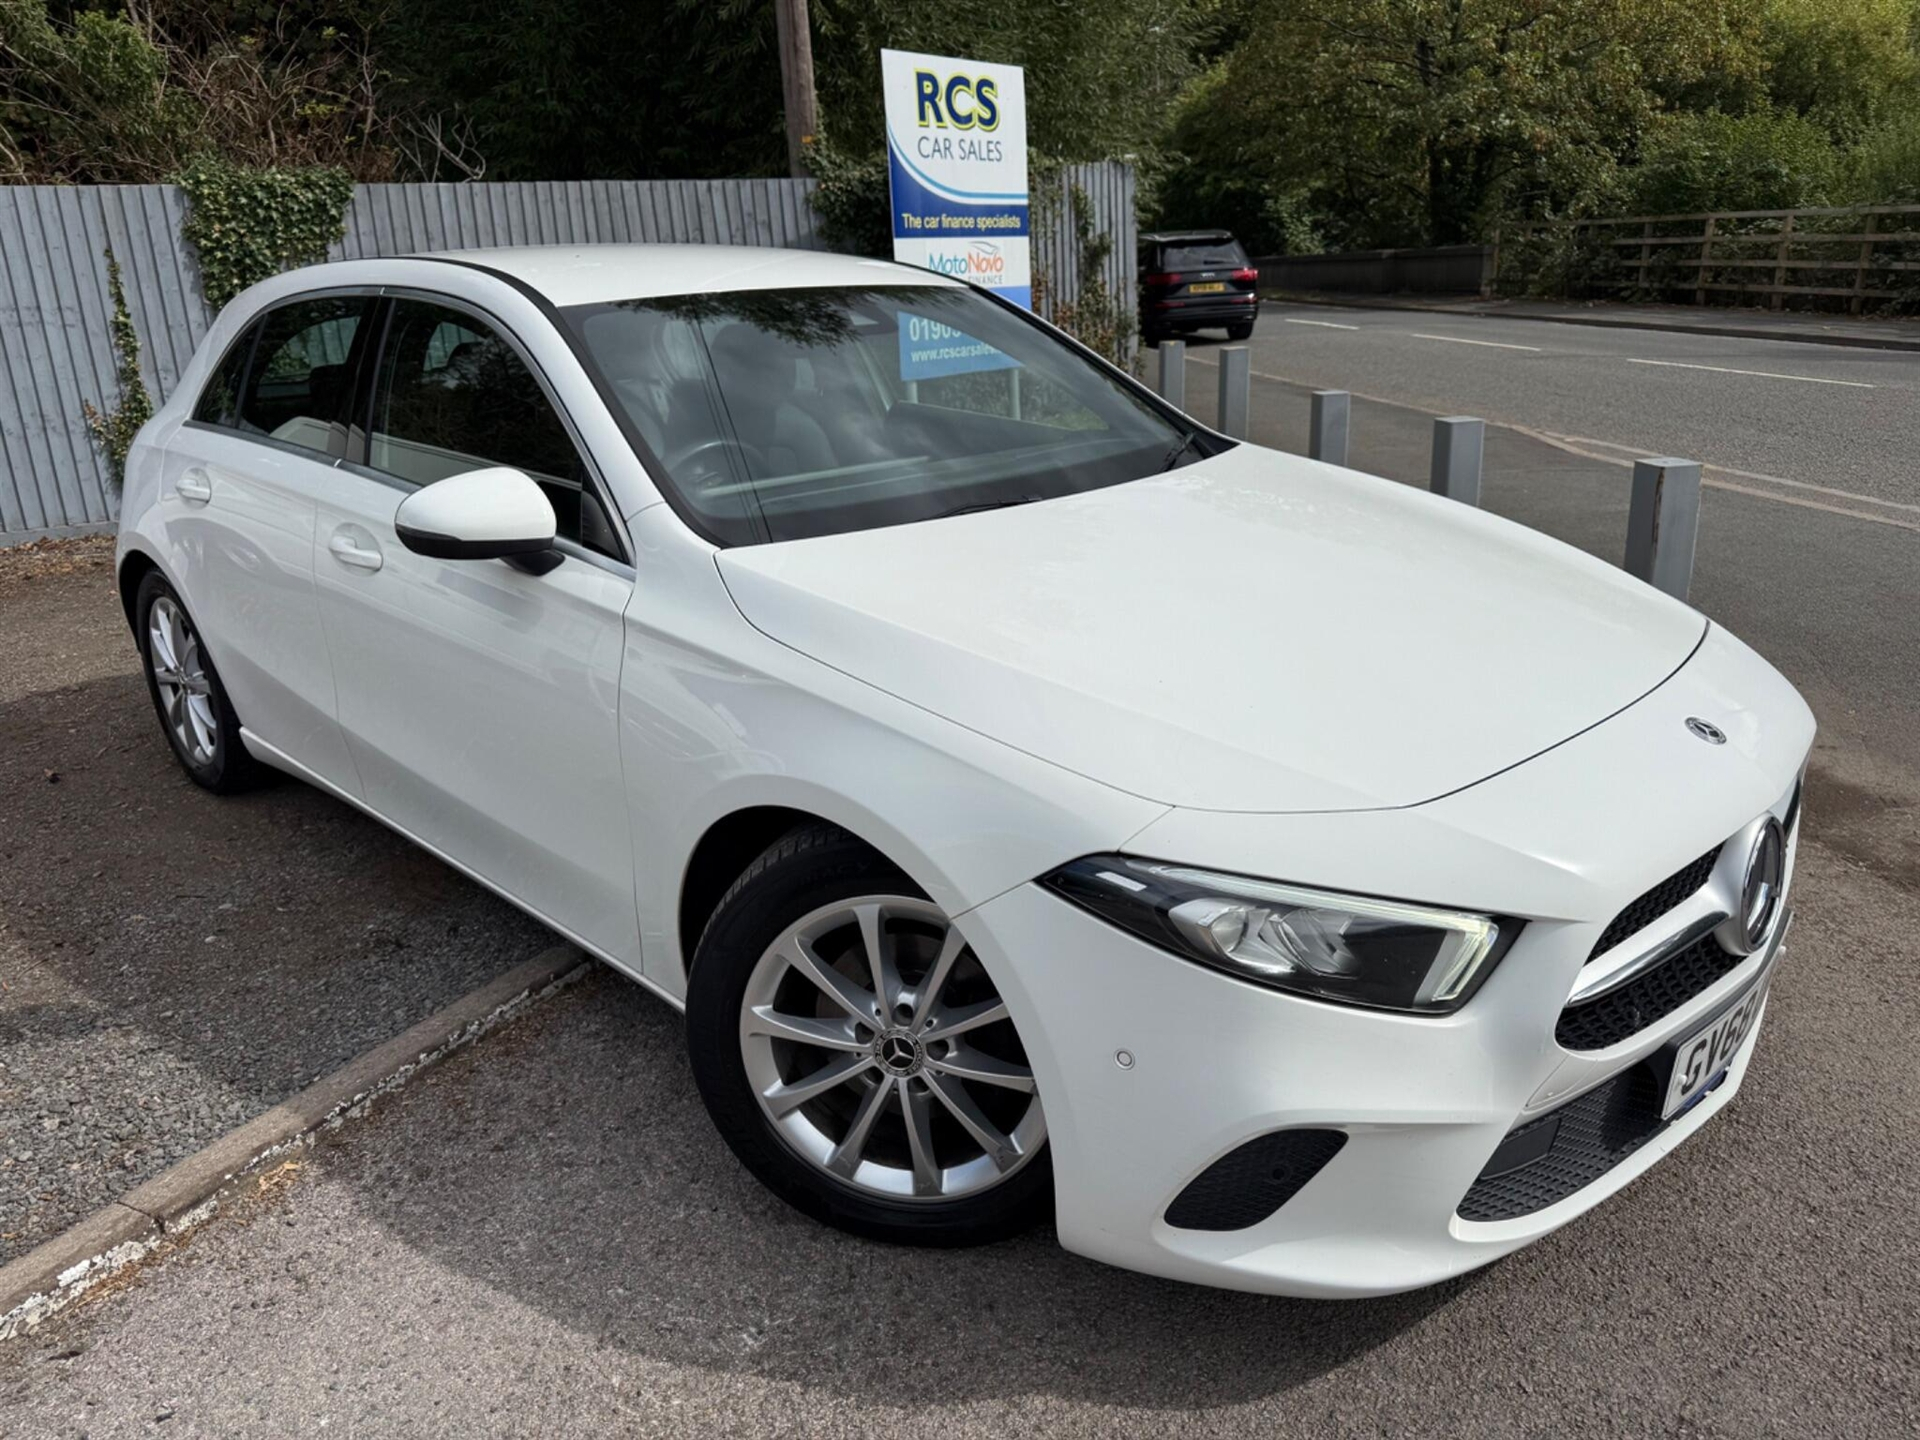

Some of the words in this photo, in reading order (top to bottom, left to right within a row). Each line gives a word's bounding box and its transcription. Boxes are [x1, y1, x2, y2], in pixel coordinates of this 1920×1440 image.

[914, 68, 999, 132] RCS
[917, 136, 953, 159] CAR
[958, 138, 1003, 162] SALES
[902, 213, 922, 229] The
[923, 215, 940, 229] car
[941, 213, 975, 229] finance
[976, 213, 1021, 232] specialists
[928, 252, 1004, 275] MotoNovo
